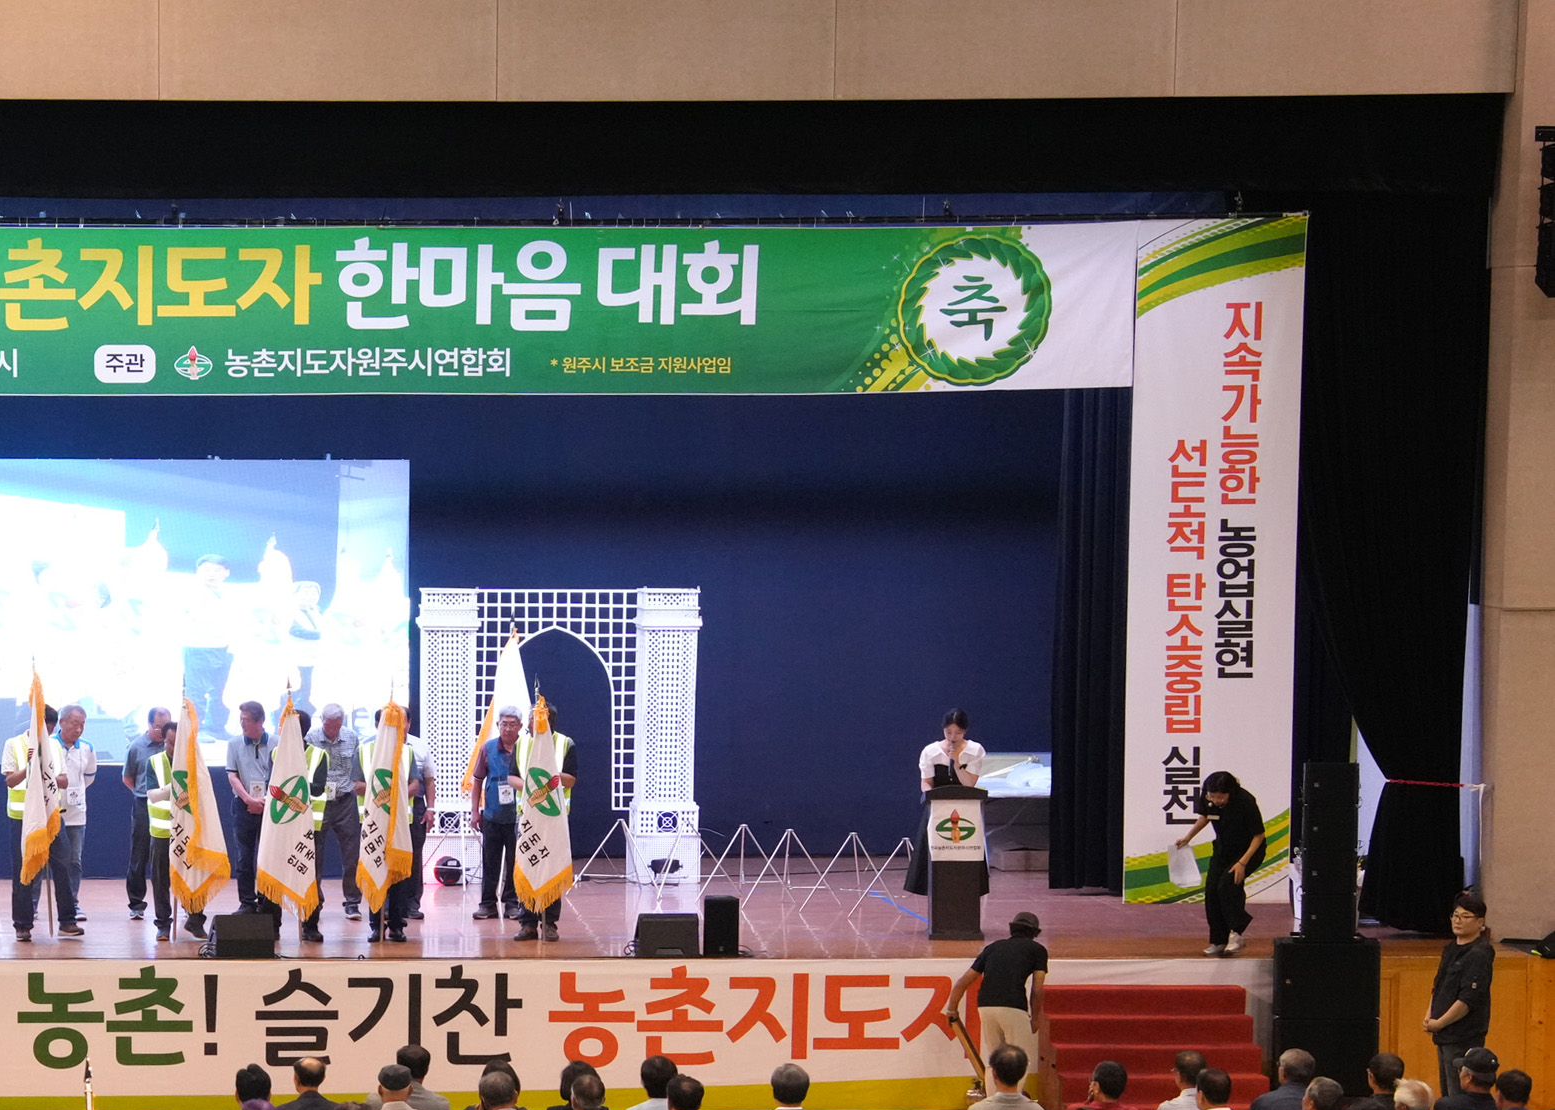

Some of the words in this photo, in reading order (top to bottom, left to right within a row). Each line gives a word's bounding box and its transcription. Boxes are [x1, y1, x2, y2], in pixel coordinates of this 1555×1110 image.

[335, 236, 582, 332] 한마음
[596, 239, 760, 326] 대회
[939, 275, 1007, 341] 축
[104, 353, 146, 375] 주관
[223, 346, 512, 378] 농촌지도자원주시연합회
[562, 356, 607, 375] 원주시
[610, 356, 655, 375] 보조금
[658, 356, 732, 375] 지원사업임
[1219, 301, 1263, 505] 지속가능한
[1166, 439, 1208, 560] 선도적
[1215, 518, 1257, 679] 농업실현
[1164, 573, 1206, 734] 탄소중립
[1162, 746, 1201, 825] 실천
[17, 964, 219, 1070] 농촌!
[255, 964, 523, 1067] 슬기찬
